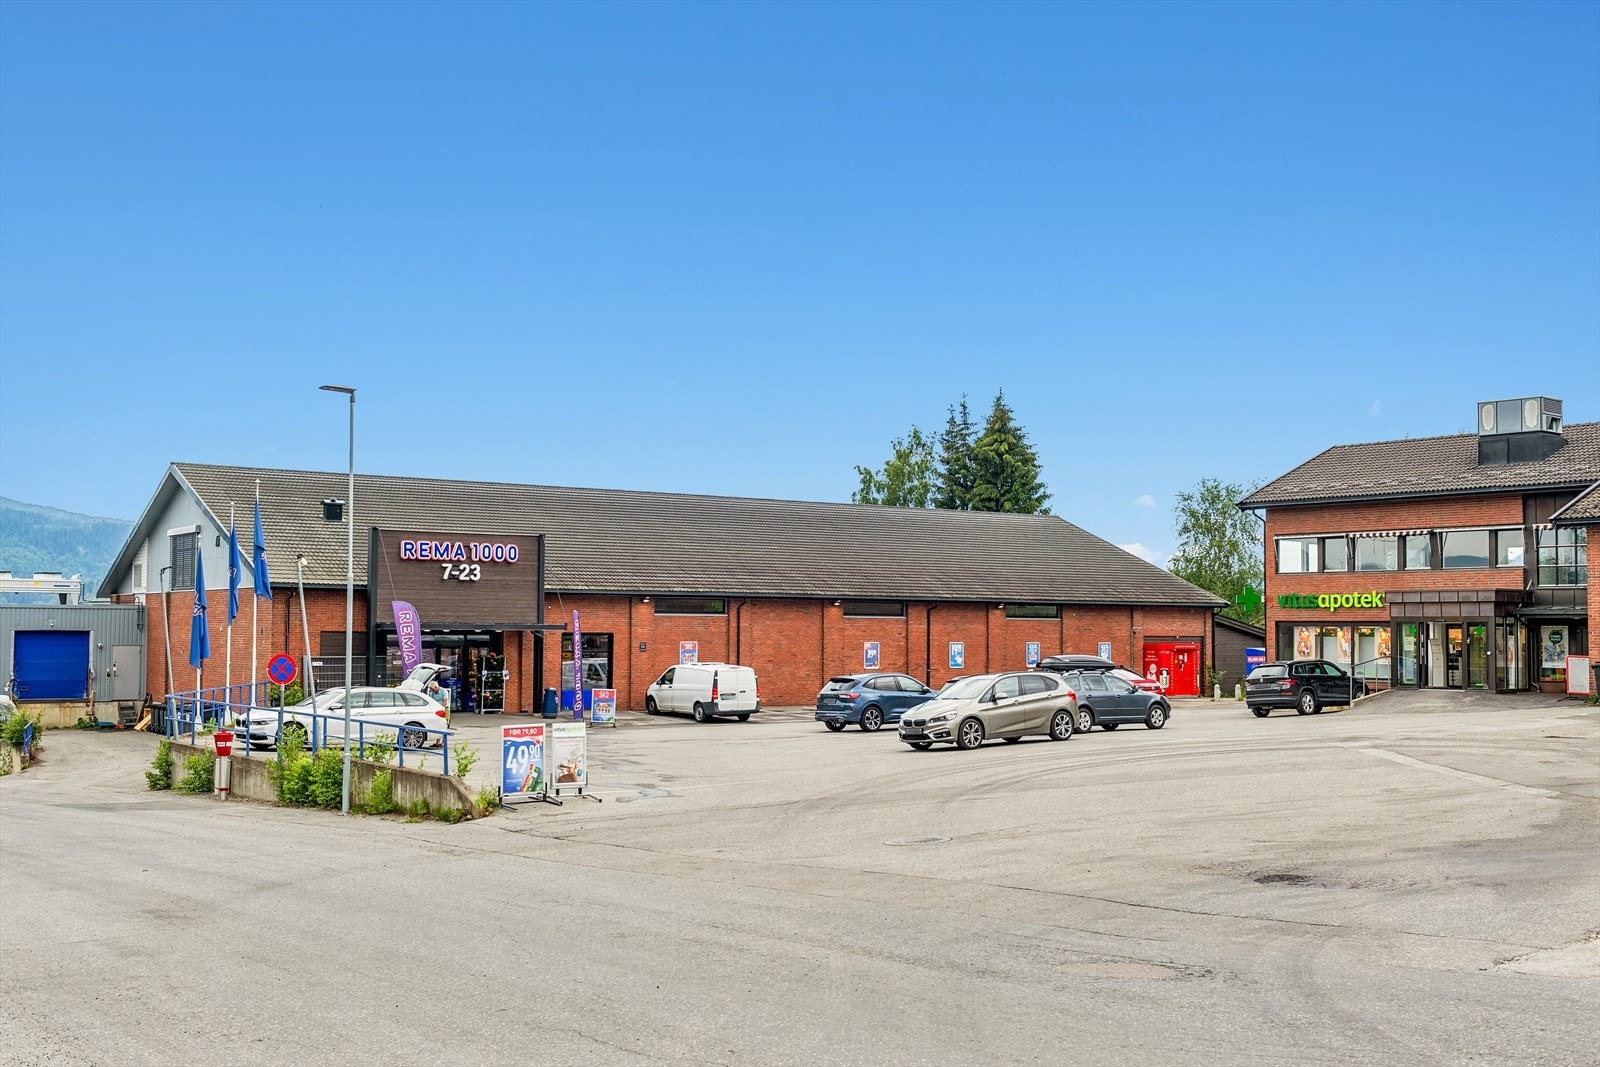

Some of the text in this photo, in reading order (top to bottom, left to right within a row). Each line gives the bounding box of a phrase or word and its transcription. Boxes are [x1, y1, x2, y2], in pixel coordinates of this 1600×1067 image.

[400, 540, 519, 563] REMA 1000
[441, 563, 481, 581] 7-23
[1277, 591, 1384, 612] vitusapotek
[399, 611, 417, 664] REMA
[509, 728, 521, 736] FØR
